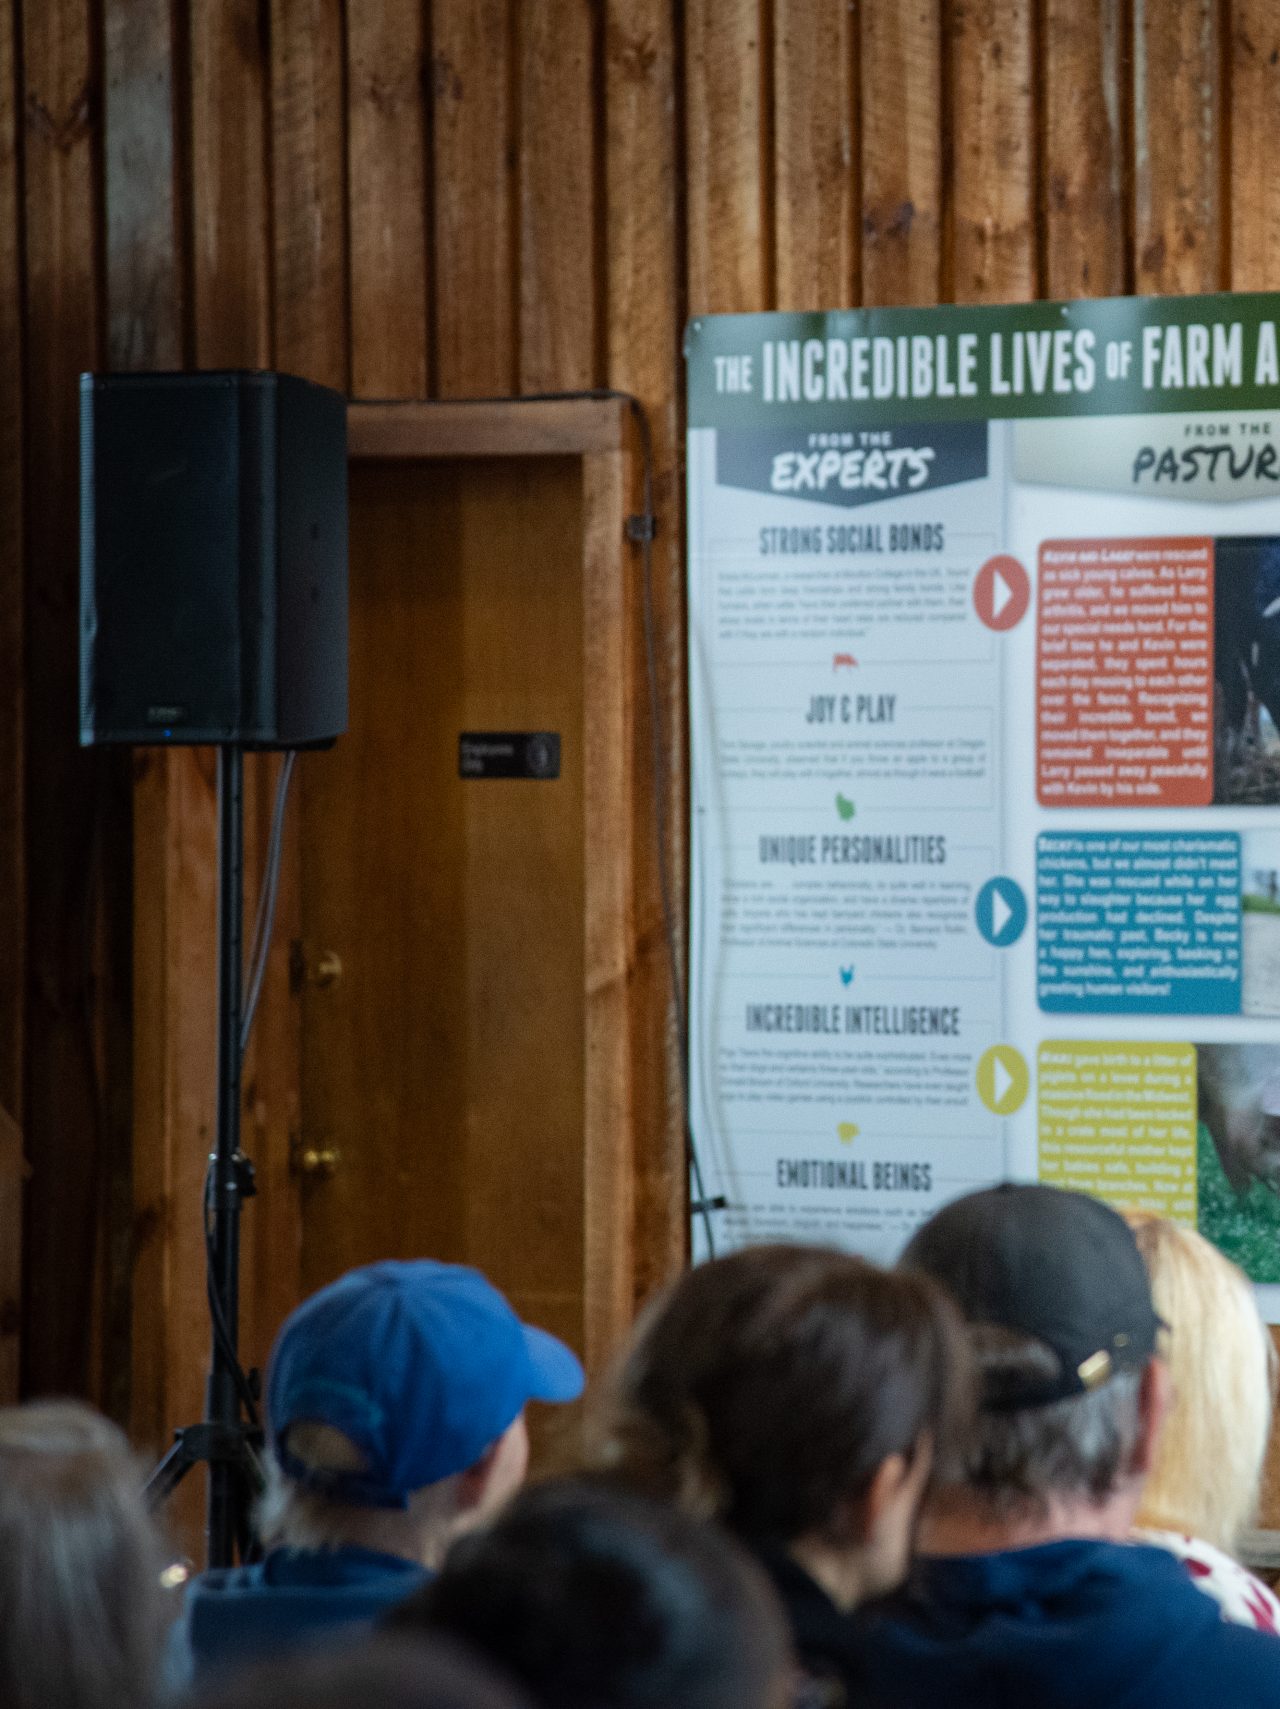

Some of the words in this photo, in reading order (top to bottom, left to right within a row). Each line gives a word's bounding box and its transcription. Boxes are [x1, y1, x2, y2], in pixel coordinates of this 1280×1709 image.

[714, 356, 753, 393] THE
[762, 333, 978, 402] INCREDIBLE
[990, 329, 1096, 395] LIVES
[1106, 341, 1132, 378] OF
[1142, 322, 1244, 389] FARM
[808, 432, 853, 448] FROM
[860, 431, 892, 447] THE
[1185, 423, 1230, 437] FROM
[1240, 421, 1272, 436] THE
[770, 446, 935, 491] EXPERTS
[759, 524, 823, 556] STRONG
[827, 524, 882, 553] SOCIAL
[889, 523, 945, 552] BONDS
[806, 695, 837, 724] JOY
[856, 694, 897, 724] PLAY
[759, 834, 816, 867] UNIQUE
[821, 834, 947, 865] PERSONALITIES
[746, 1004, 840, 1034] INCREDIBLE
[845, 1005, 960, 1036] INTELLIGENCE
[777, 1159, 867, 1190] EMOTIONAL
[873, 1161, 932, 1192] BEINGS
